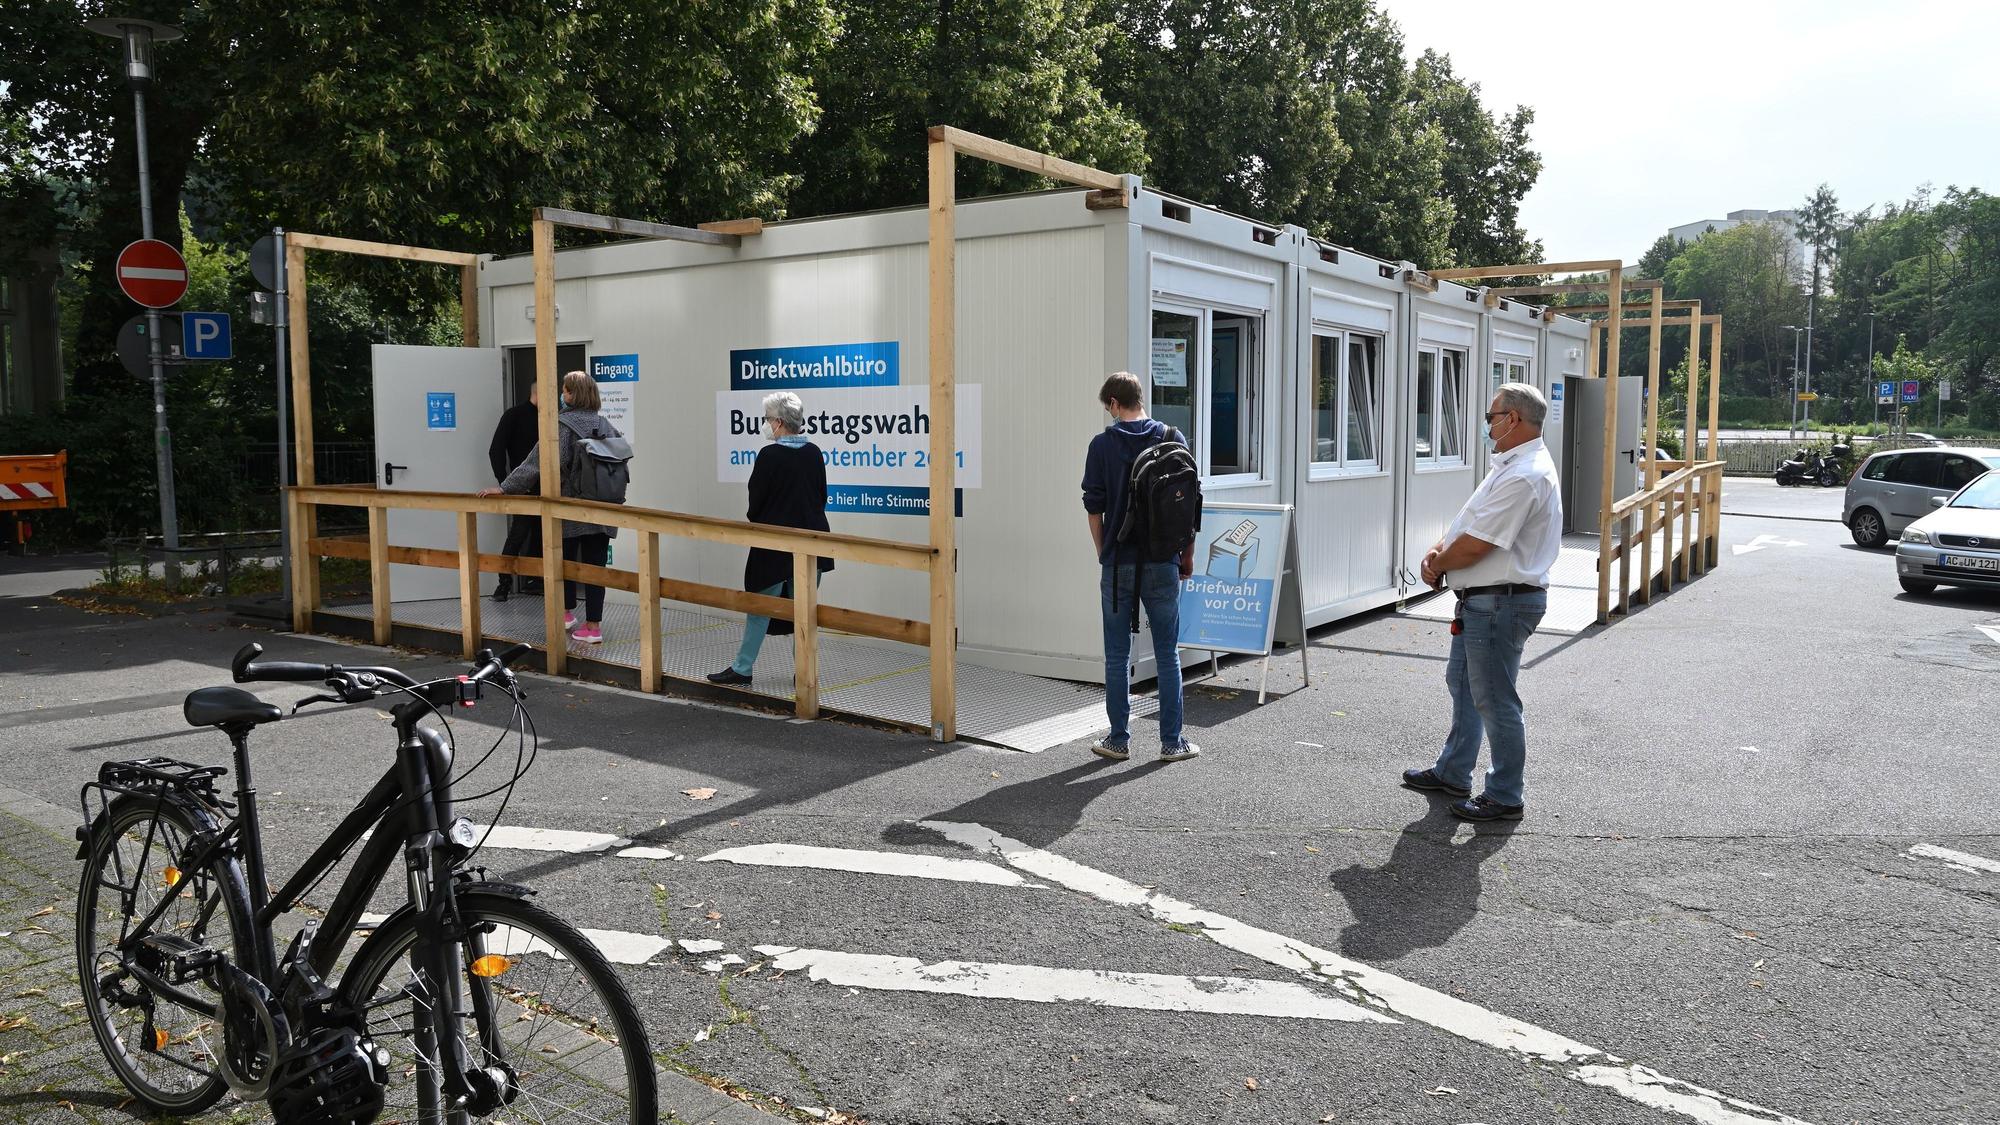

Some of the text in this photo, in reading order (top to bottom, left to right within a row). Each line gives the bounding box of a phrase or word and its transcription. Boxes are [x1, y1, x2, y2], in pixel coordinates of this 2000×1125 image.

[194, 318, 220, 353] P
[595, 362, 634, 379] Eingang
[741, 355, 887, 380] Direktwahlbüro
[730, 405, 929, 444] Buestagswah
[730, 444, 963, 468] am tember 21
[836, 492, 858, 505] hier
[861, 493, 883, 506] Ihre
[886, 494, 930, 508] Stimme
[1946, 556, 1996, 569] AC UW 121
[1186, 580, 1257, 597] Briefwahl
[1205, 597, 1262, 612] vor Ort
